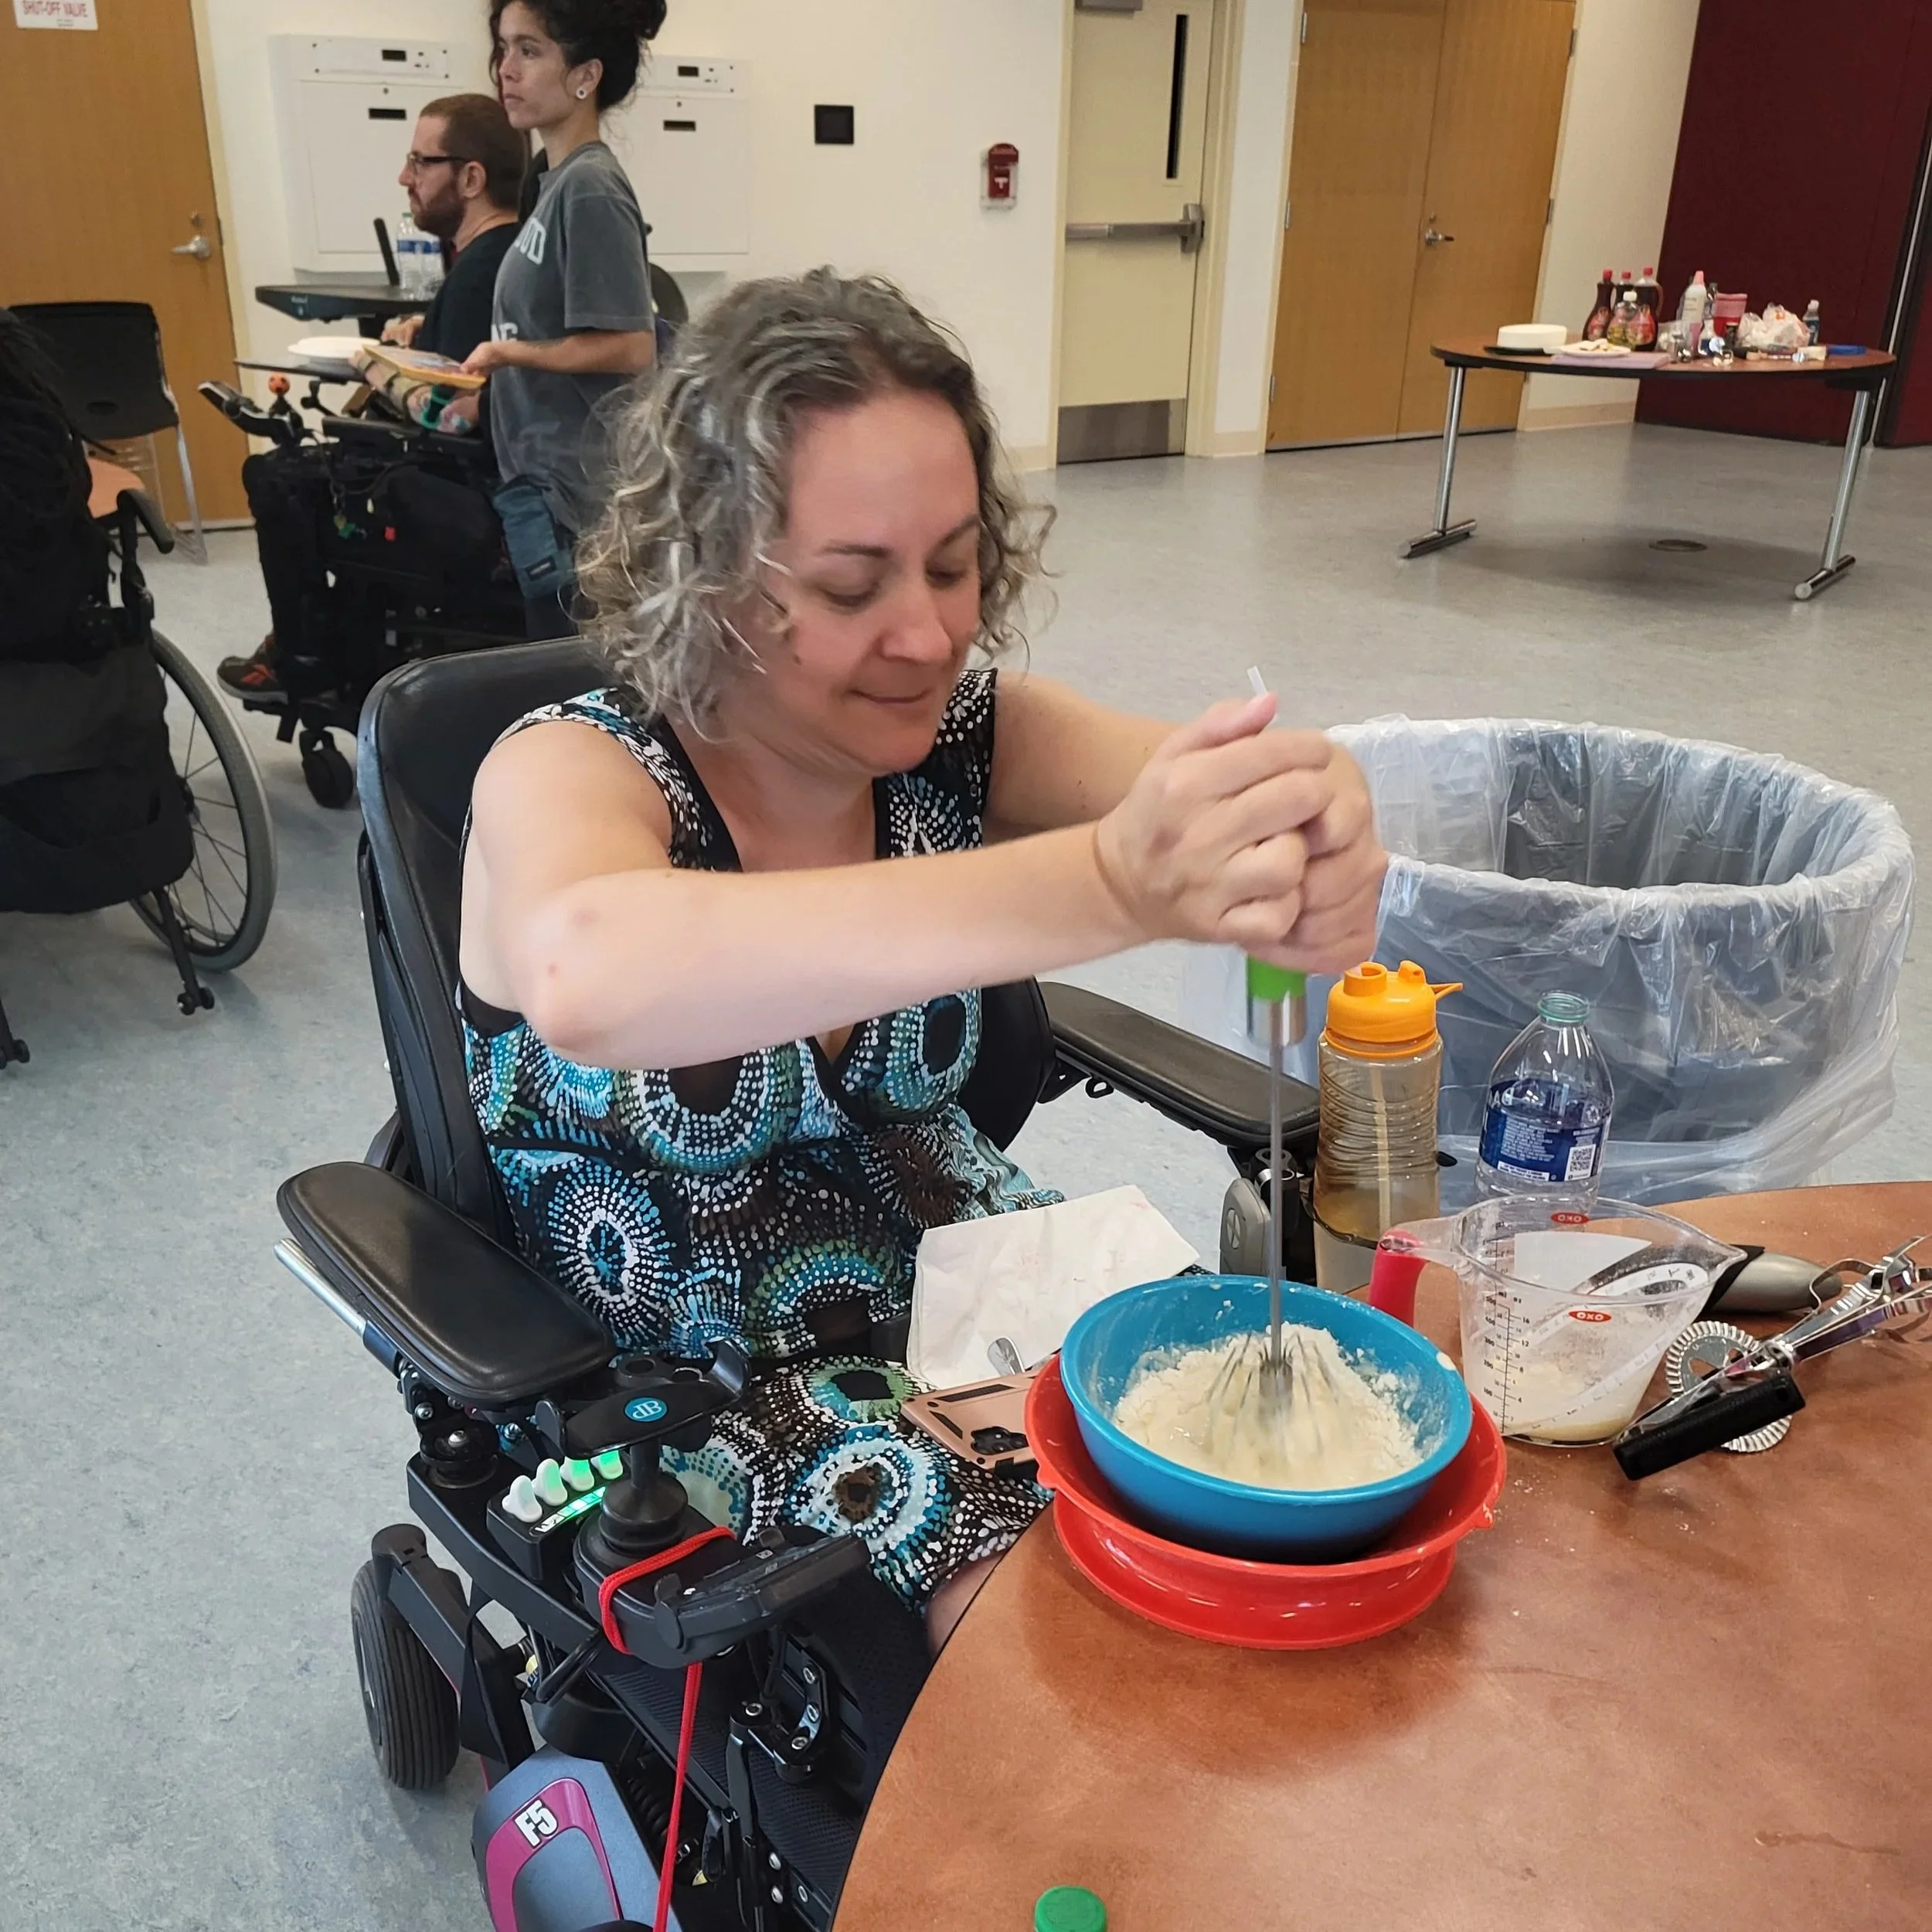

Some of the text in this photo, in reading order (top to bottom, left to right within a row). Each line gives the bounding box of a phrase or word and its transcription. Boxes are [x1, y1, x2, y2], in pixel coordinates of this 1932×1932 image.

[1557, 1214, 1582, 1223] OXO
[1577, 1311, 1604, 1321] OXO
[514, 1799, 559, 1847] F5
